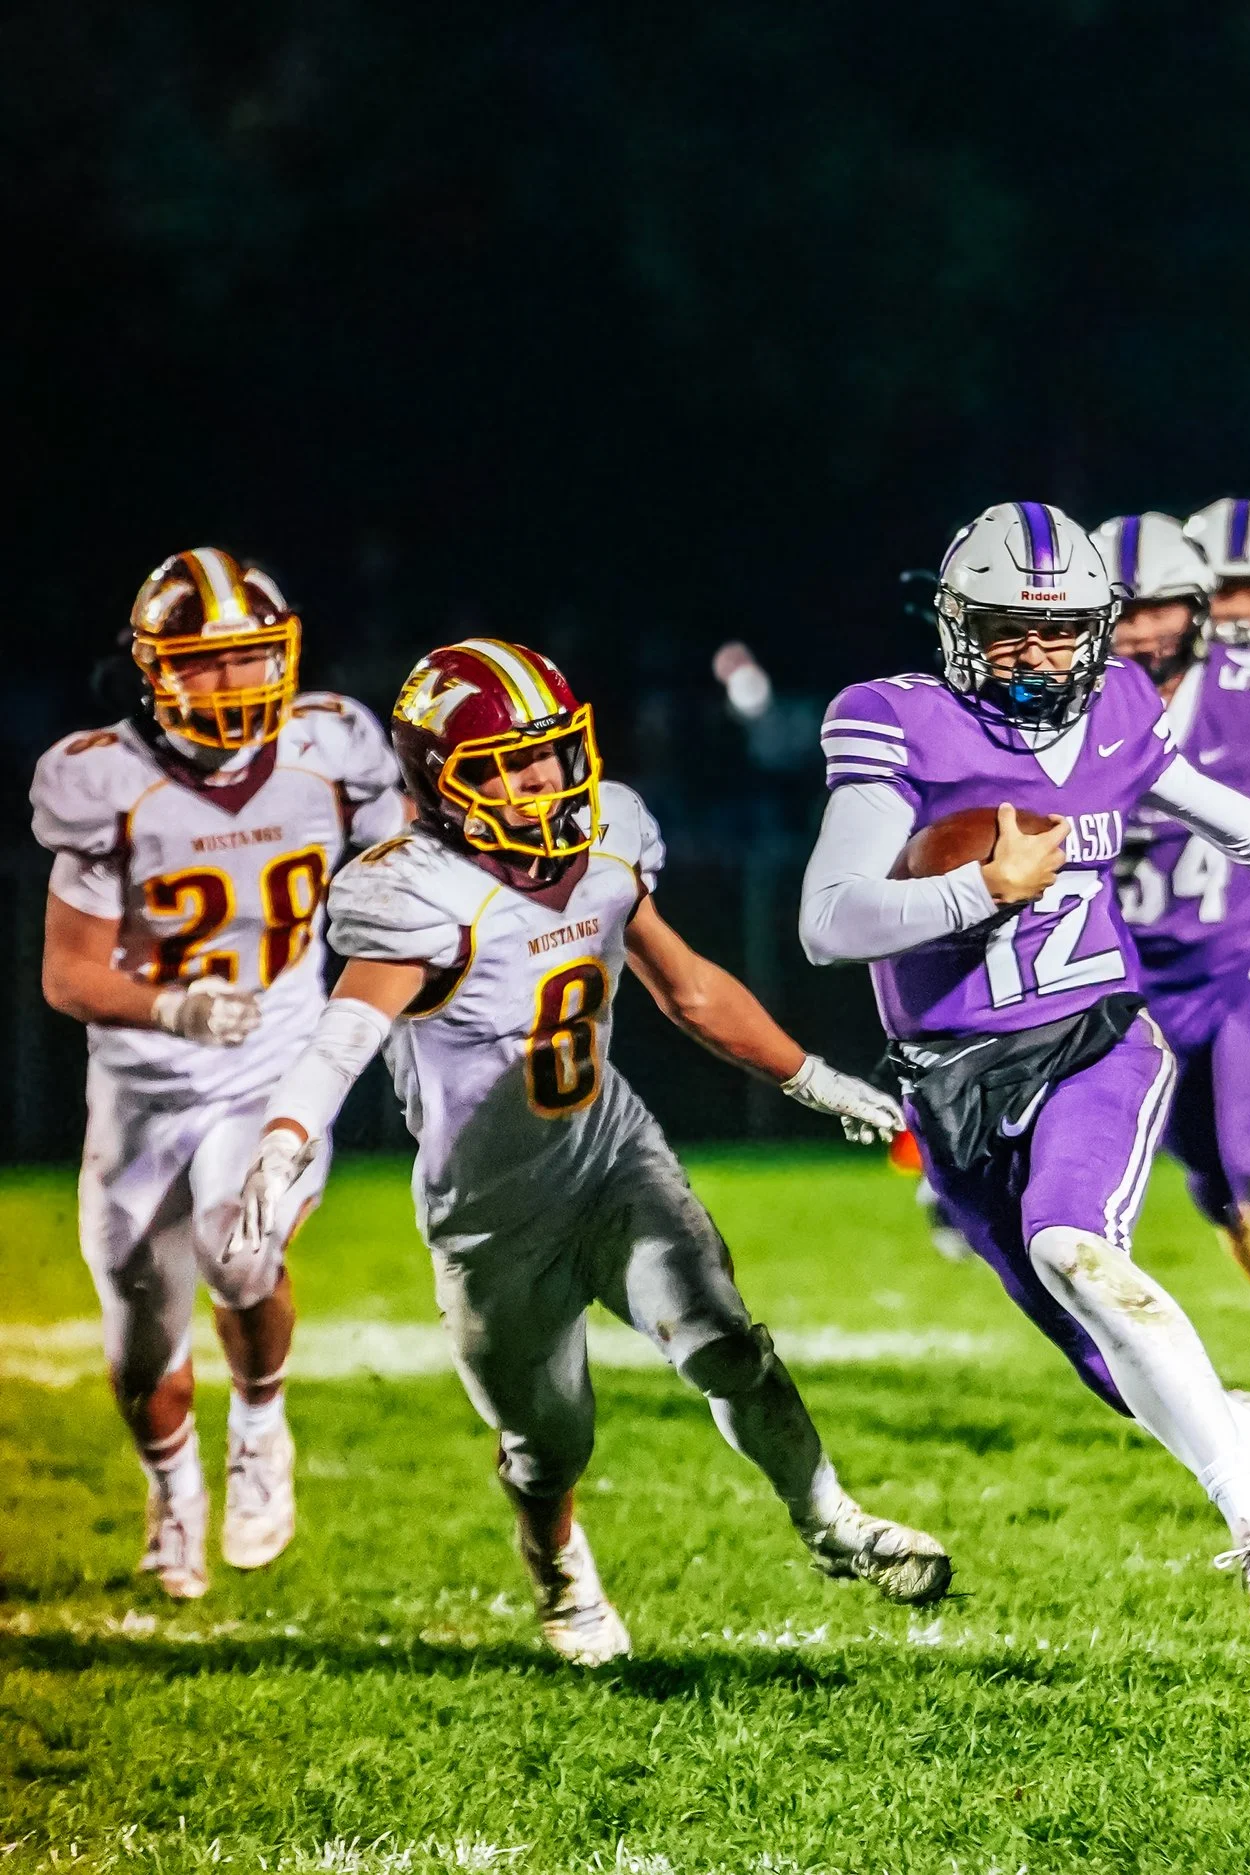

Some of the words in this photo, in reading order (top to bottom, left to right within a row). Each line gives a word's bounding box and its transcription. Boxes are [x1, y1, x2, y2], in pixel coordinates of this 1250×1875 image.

[1021, 591, 1067, 602] Riddell
[533, 717, 556, 730] VICIS
[191, 826, 283, 853] MUSTANGS
[144, 841, 328, 990] 28
[527, 918, 600, 958] MUSTANGS
[986, 870, 1127, 1009] 12
[524, 955, 609, 1120] 8
